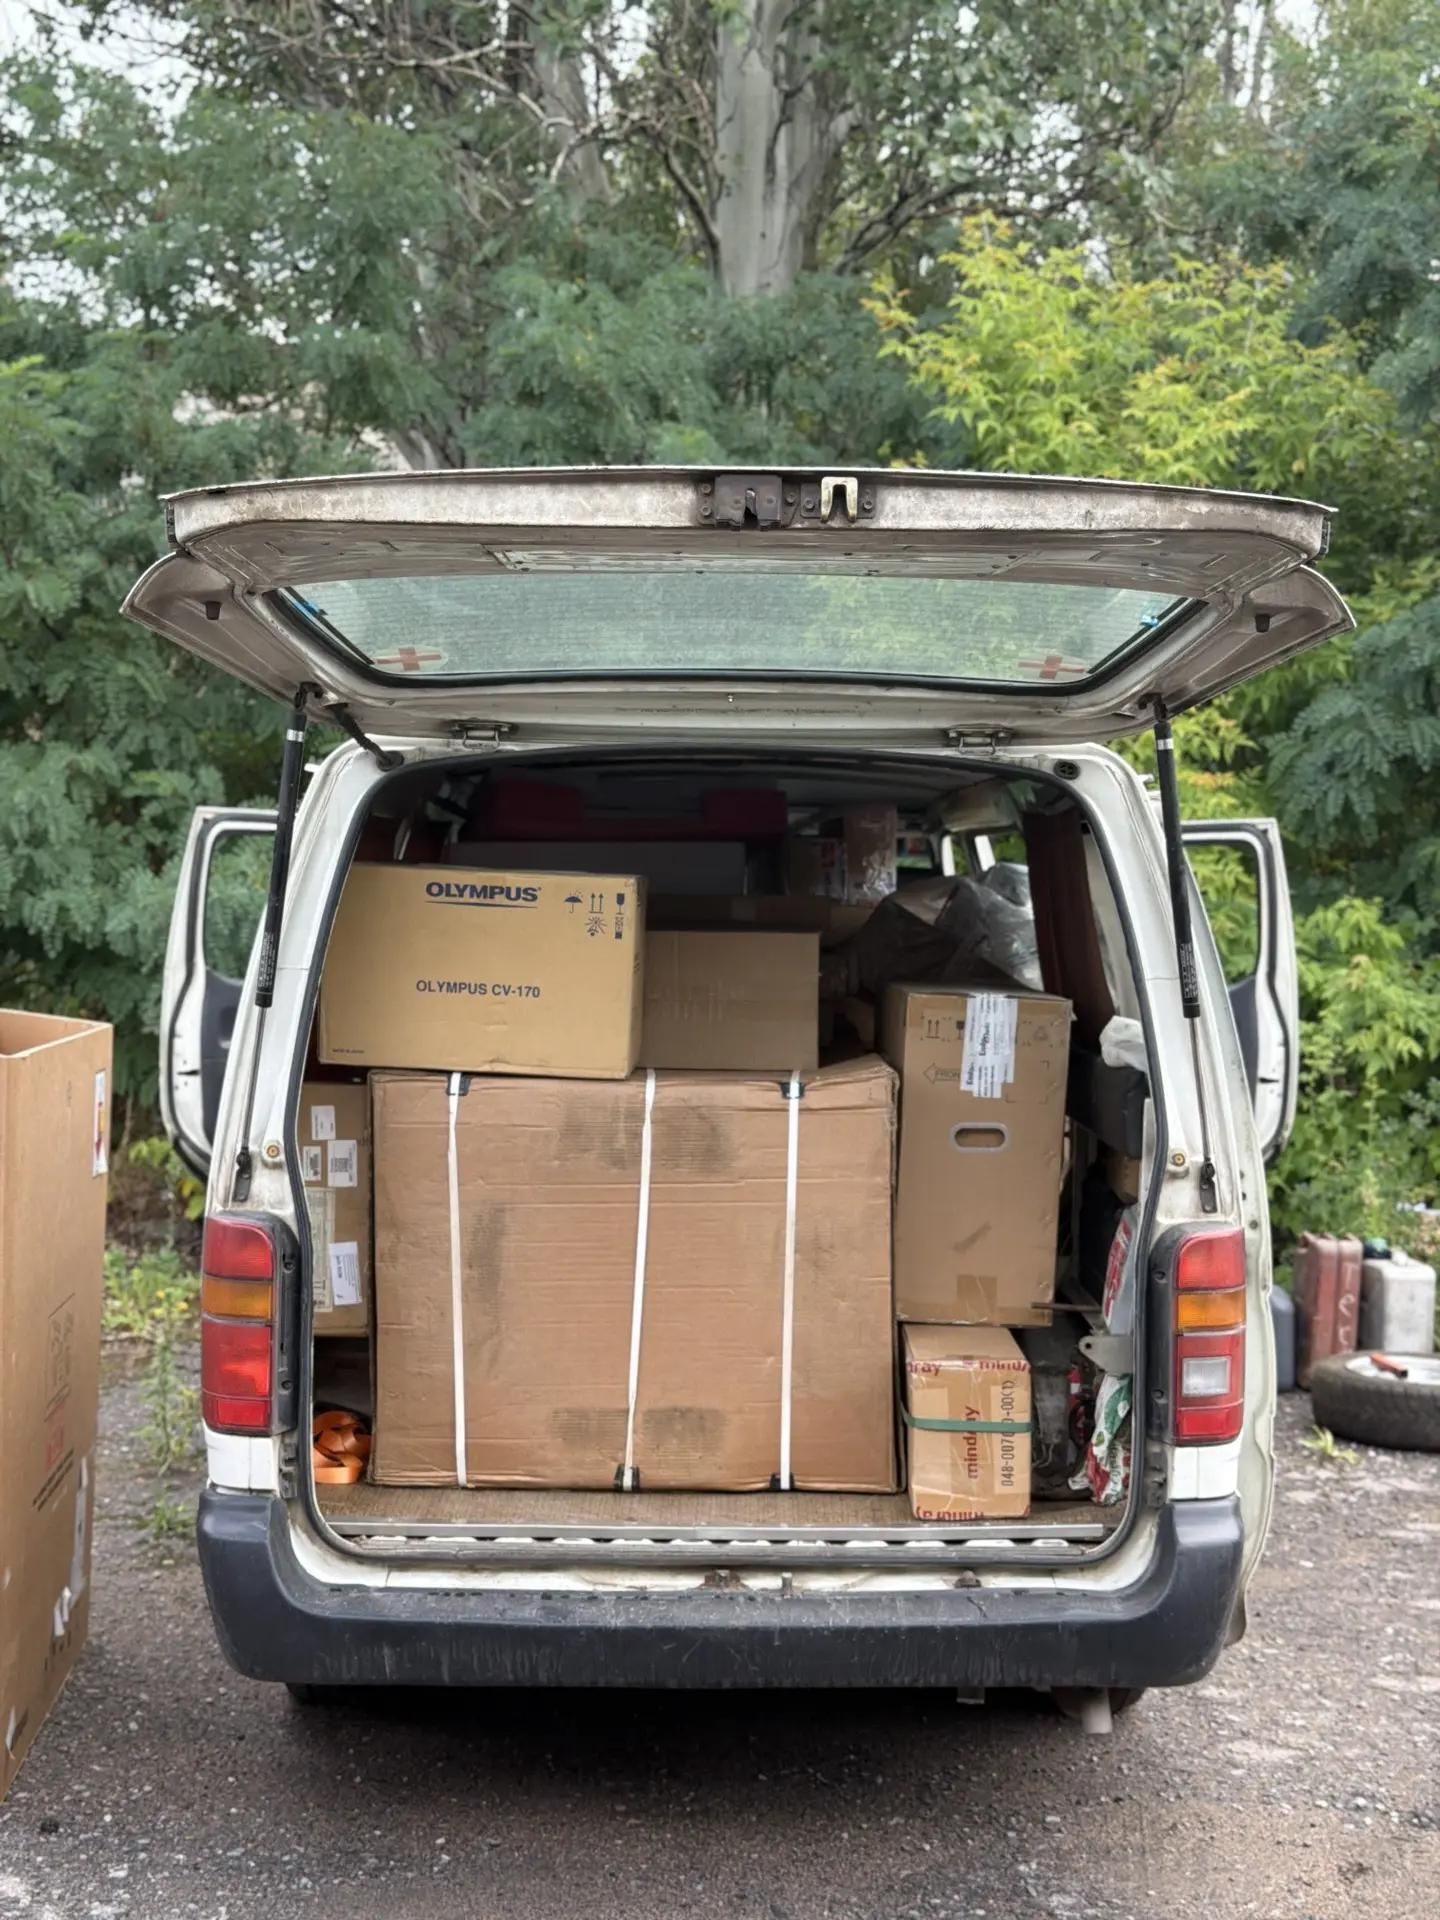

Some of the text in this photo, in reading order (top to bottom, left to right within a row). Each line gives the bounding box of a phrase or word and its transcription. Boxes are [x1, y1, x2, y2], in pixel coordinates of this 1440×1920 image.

[425, 882, 538, 902] OLYMPUS
[416, 980, 540, 998] OLYMPUS CV-170
